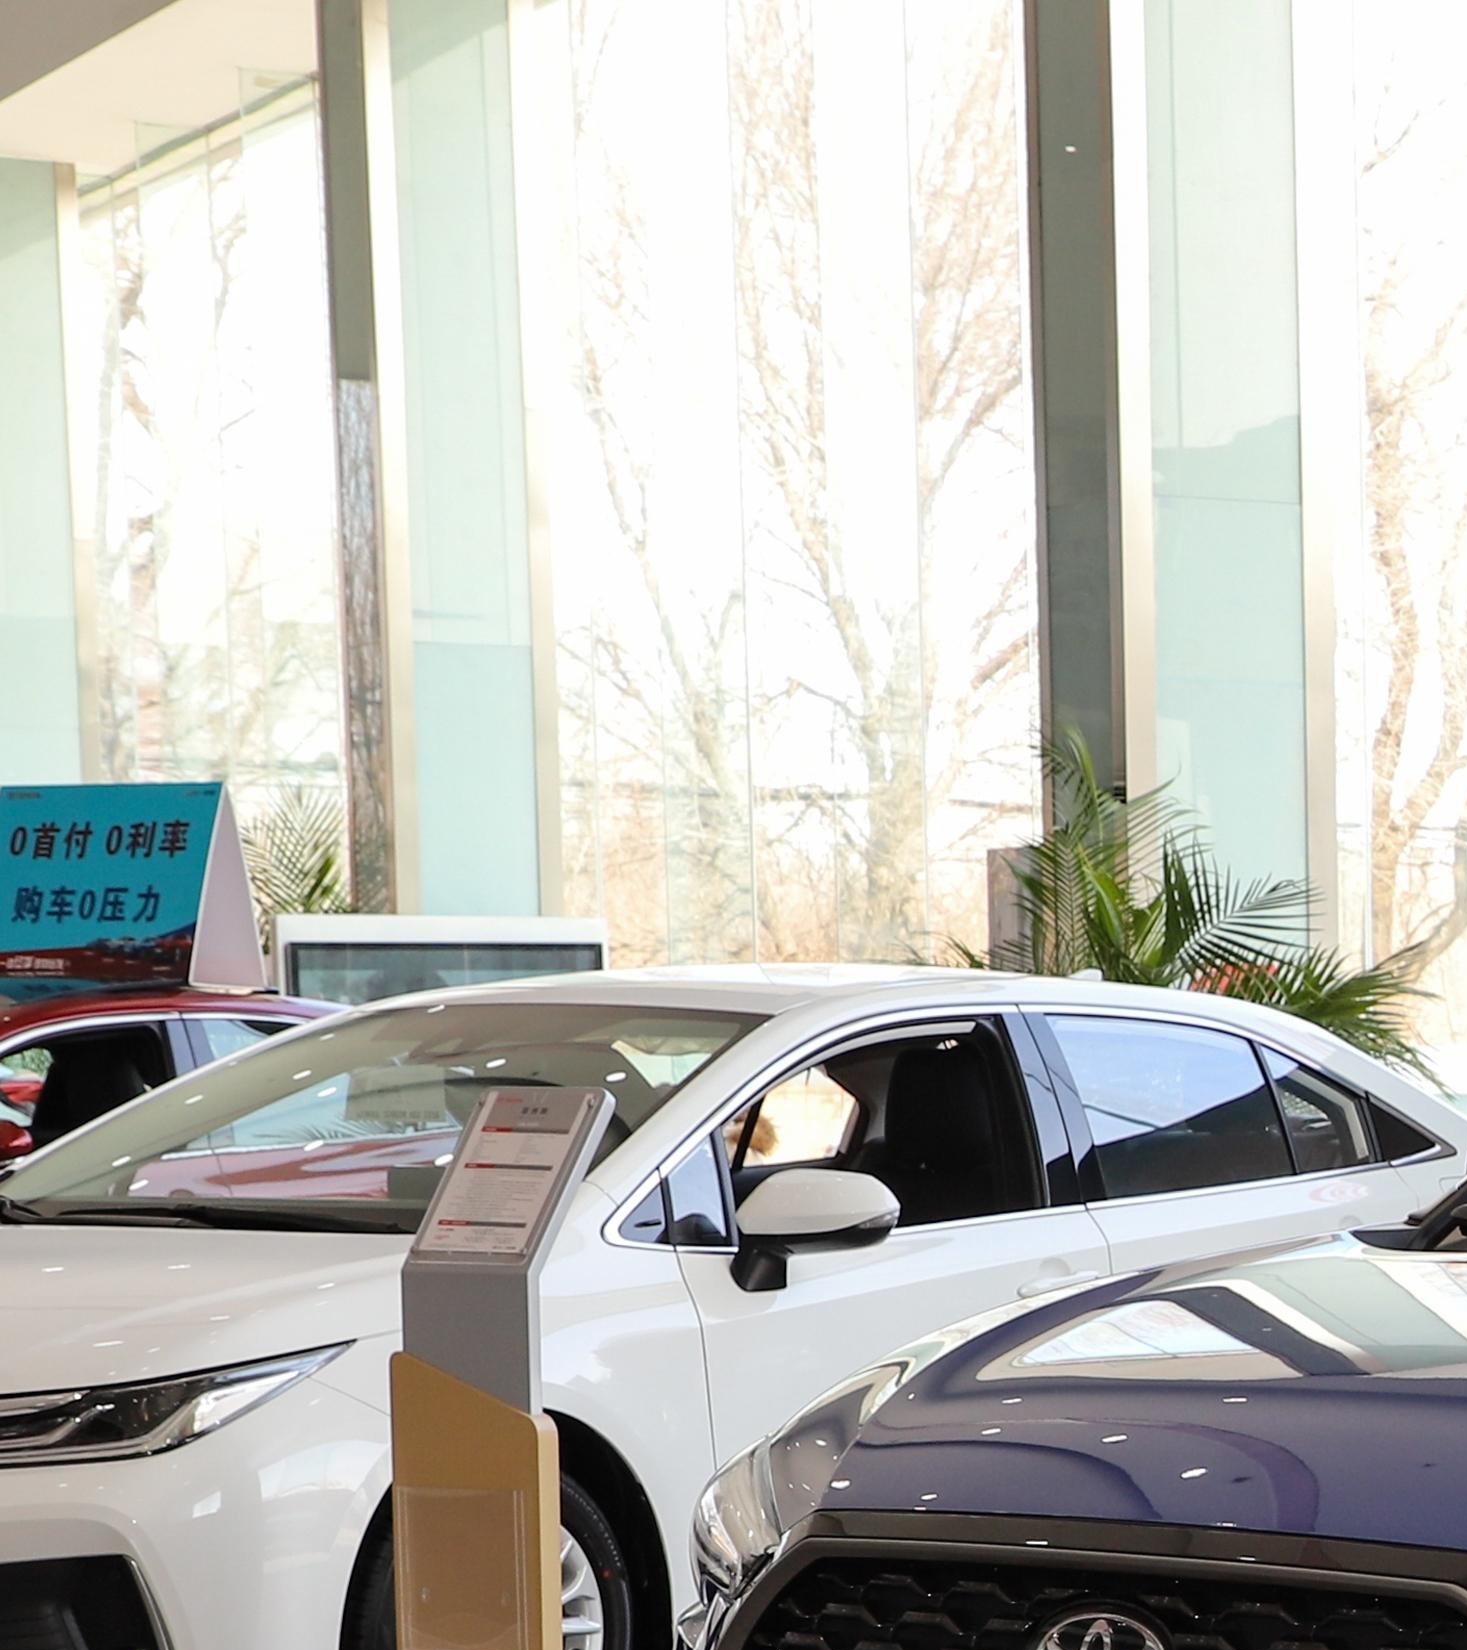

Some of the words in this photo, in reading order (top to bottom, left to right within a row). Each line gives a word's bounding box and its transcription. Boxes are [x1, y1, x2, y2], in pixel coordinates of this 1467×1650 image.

[9, 821, 93, 860] 0首付
[105, 819, 190, 859] 0利率
[11, 886, 161, 924] 购车0压力
